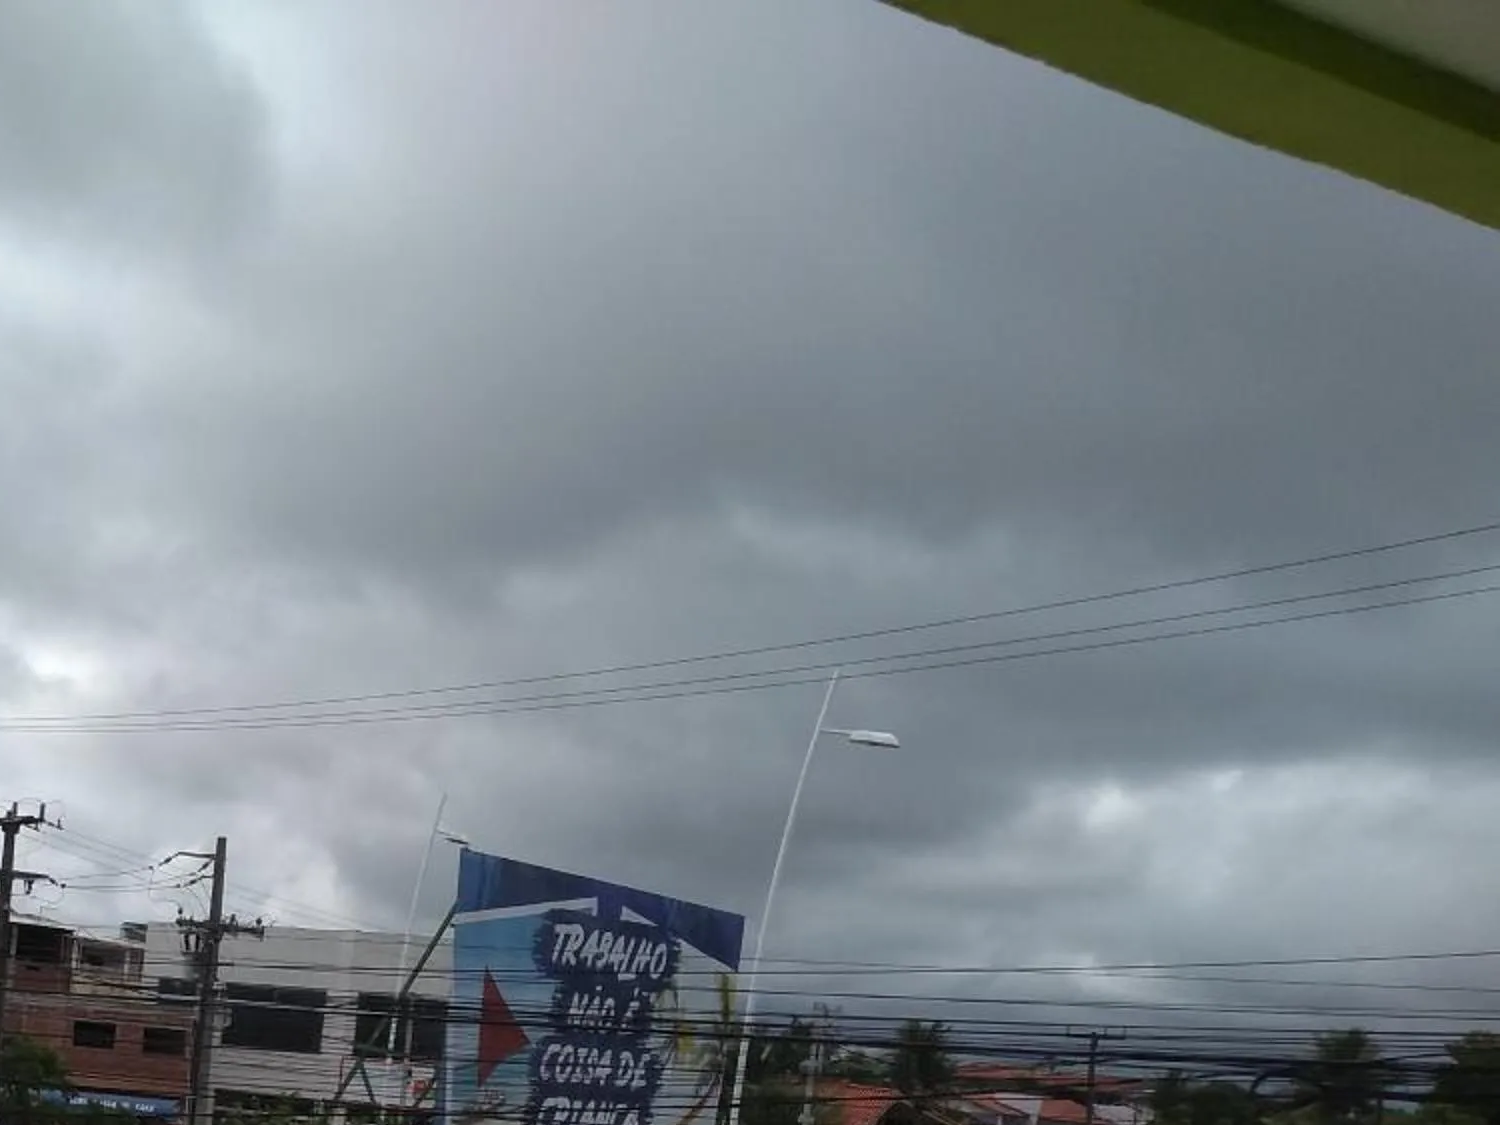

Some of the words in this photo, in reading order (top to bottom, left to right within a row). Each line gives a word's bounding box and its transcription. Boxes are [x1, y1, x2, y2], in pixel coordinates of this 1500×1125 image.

[552, 923, 668, 981] TRABALHO
[540, 1043, 613, 1085] COISA
[614, 1050, 652, 1091] DE
